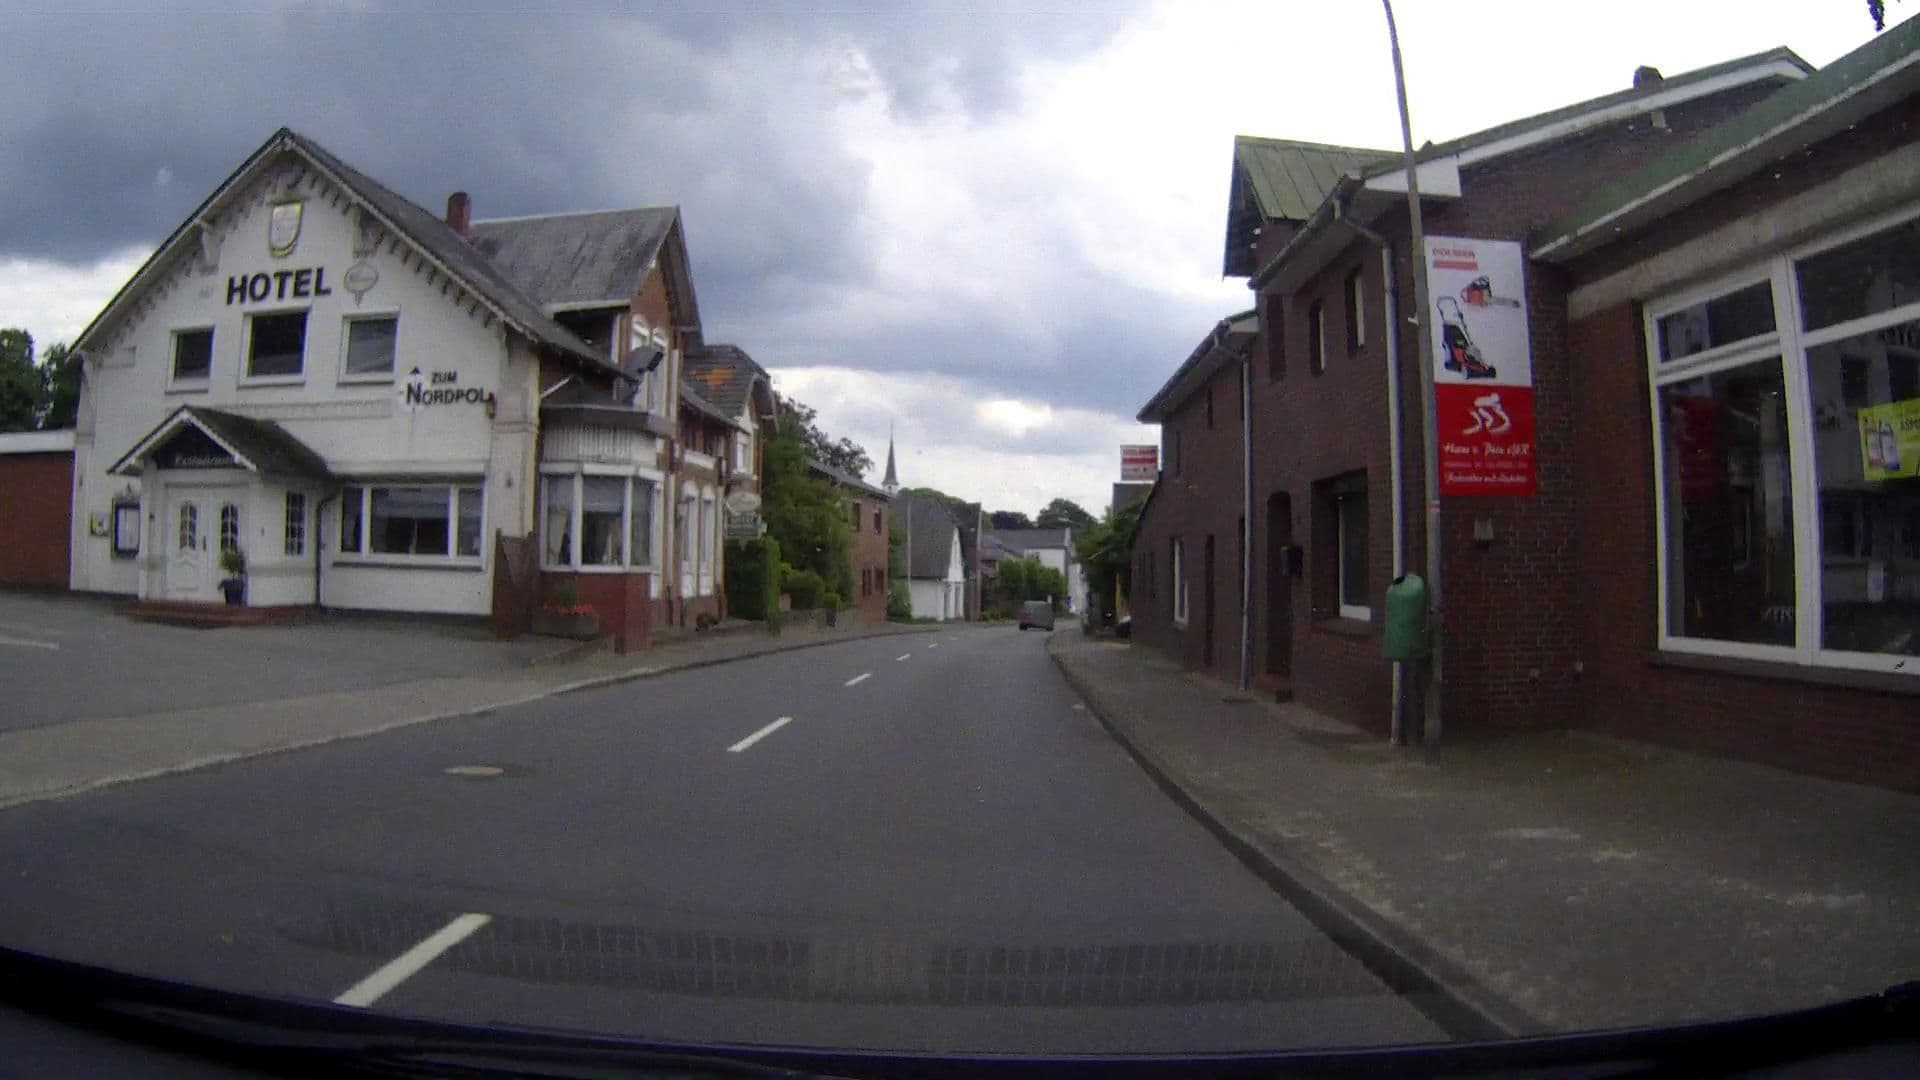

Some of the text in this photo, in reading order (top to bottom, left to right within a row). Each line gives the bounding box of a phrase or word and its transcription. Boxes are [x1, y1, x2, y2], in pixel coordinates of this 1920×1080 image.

[226, 267, 332, 305] HOTEL
[431, 371, 458, 384] ZUM
[406, 383, 488, 405] NORDPOL
